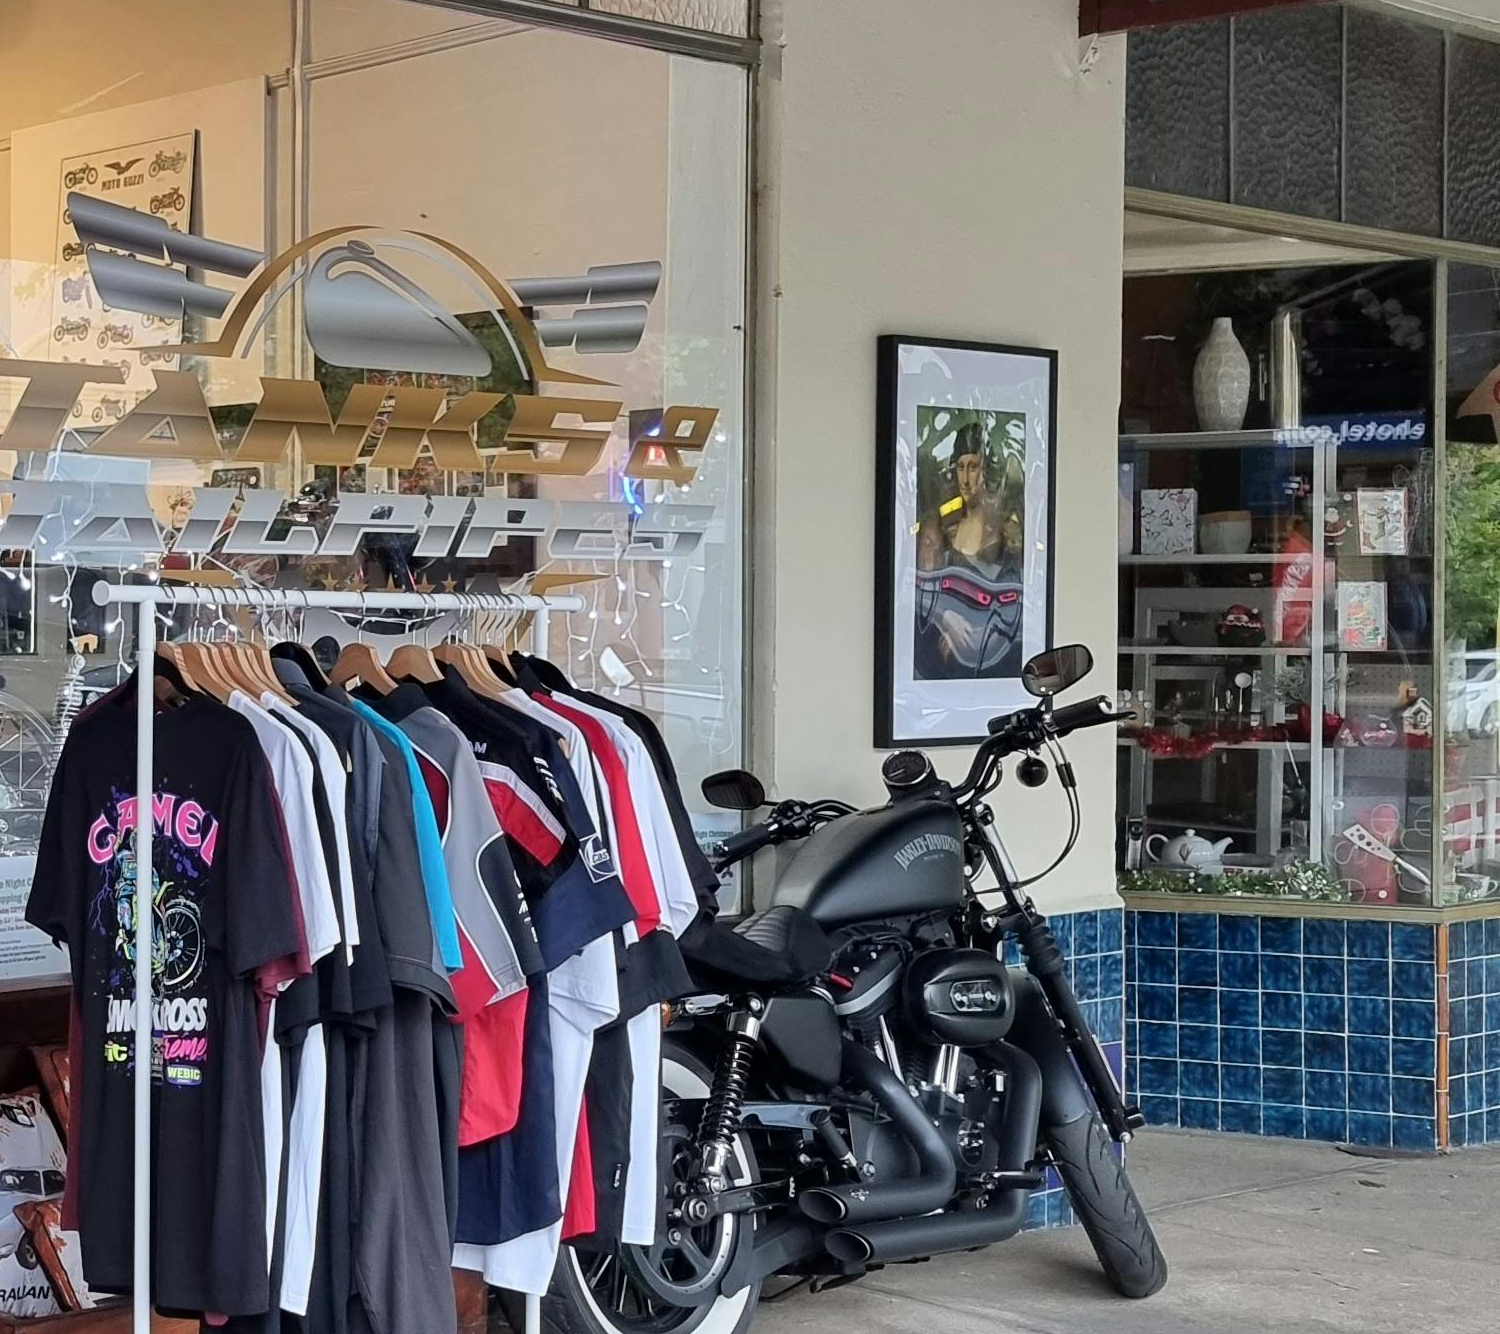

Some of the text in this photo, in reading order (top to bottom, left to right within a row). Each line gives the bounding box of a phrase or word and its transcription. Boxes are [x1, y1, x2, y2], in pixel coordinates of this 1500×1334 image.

[101, 173, 145, 192] MOTO GUZZI
[625, 404, 719, 484] &
[5, 879, 25, 890] Night
